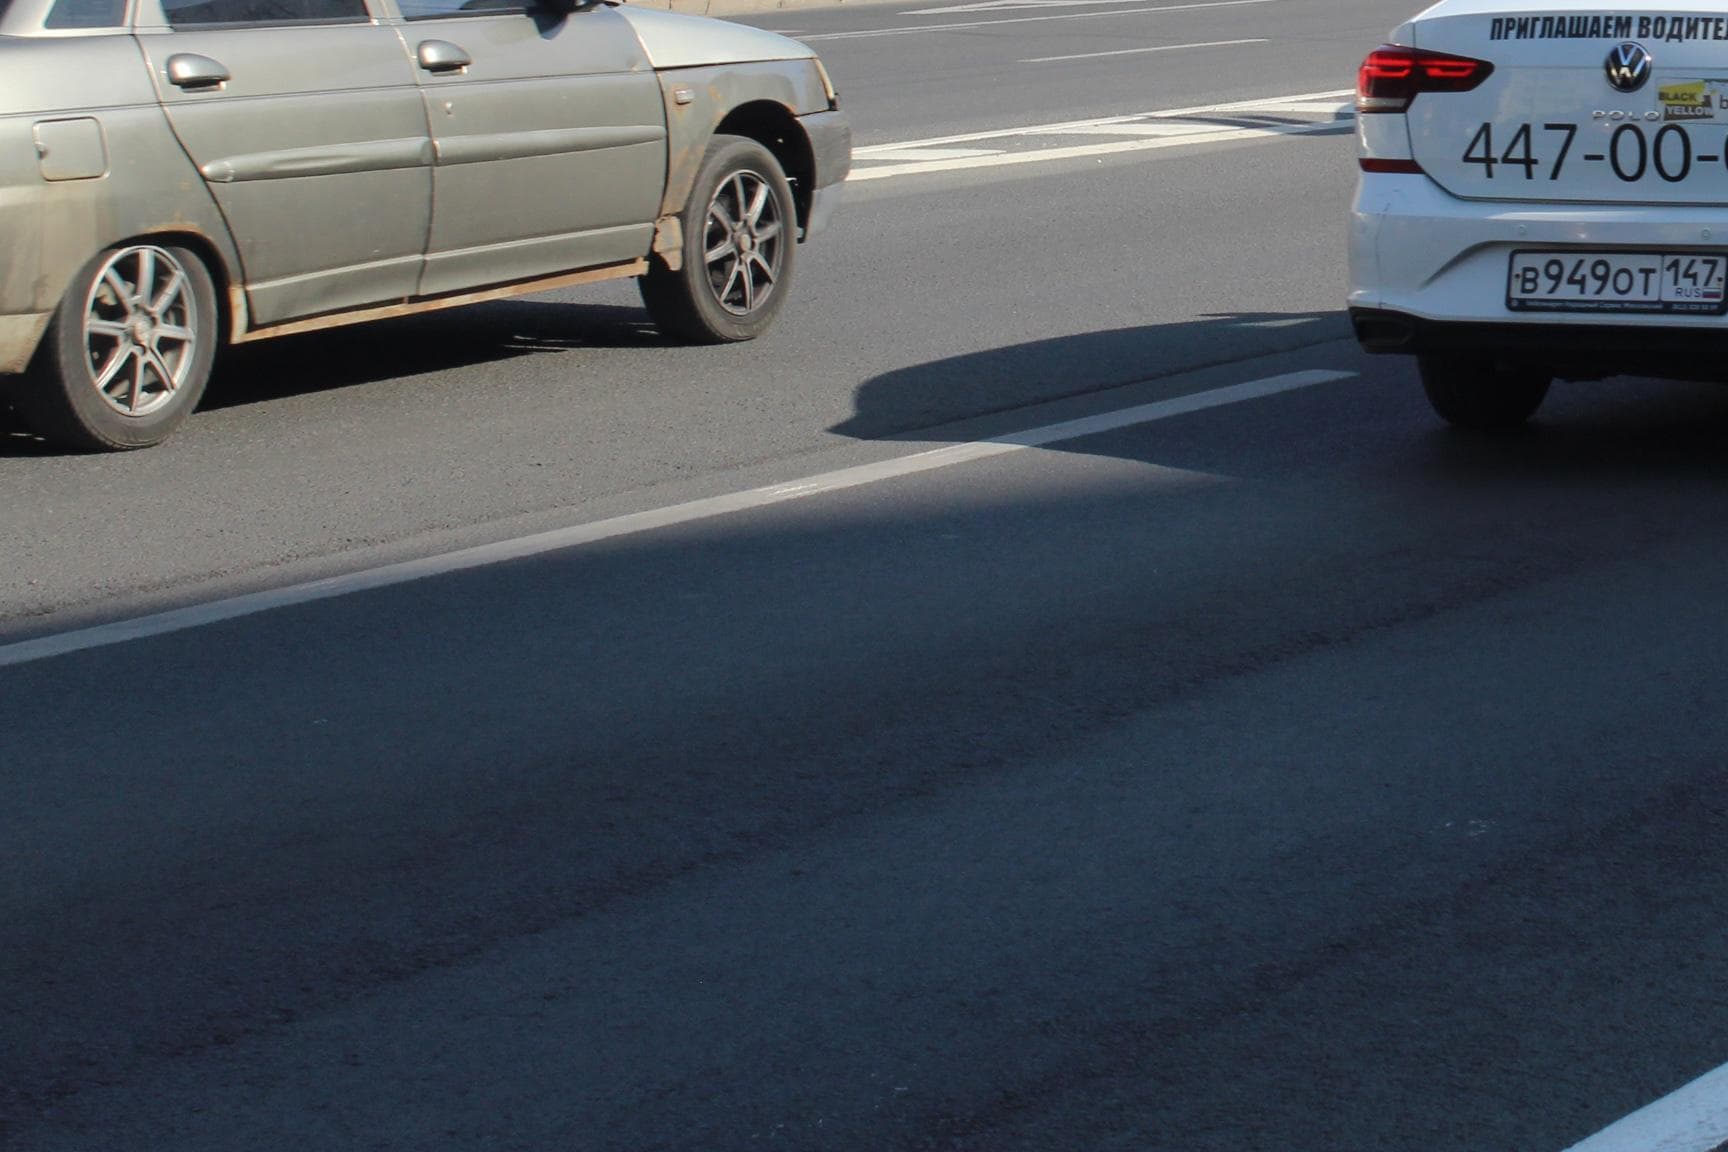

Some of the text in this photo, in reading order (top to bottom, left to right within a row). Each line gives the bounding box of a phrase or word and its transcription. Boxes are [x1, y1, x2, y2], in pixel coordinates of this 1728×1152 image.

[1489, 15, 1633, 41] ПРИГЛАШАЕМ
[1658, 91, 1698, 102] BLACK
[1591, 109, 1661, 122] POLO
[1666, 105, 1714, 118] YELLOW
[1520, 258, 1719, 296] В949ОТ 147
[1675, 287, 1702, 298] RUS
